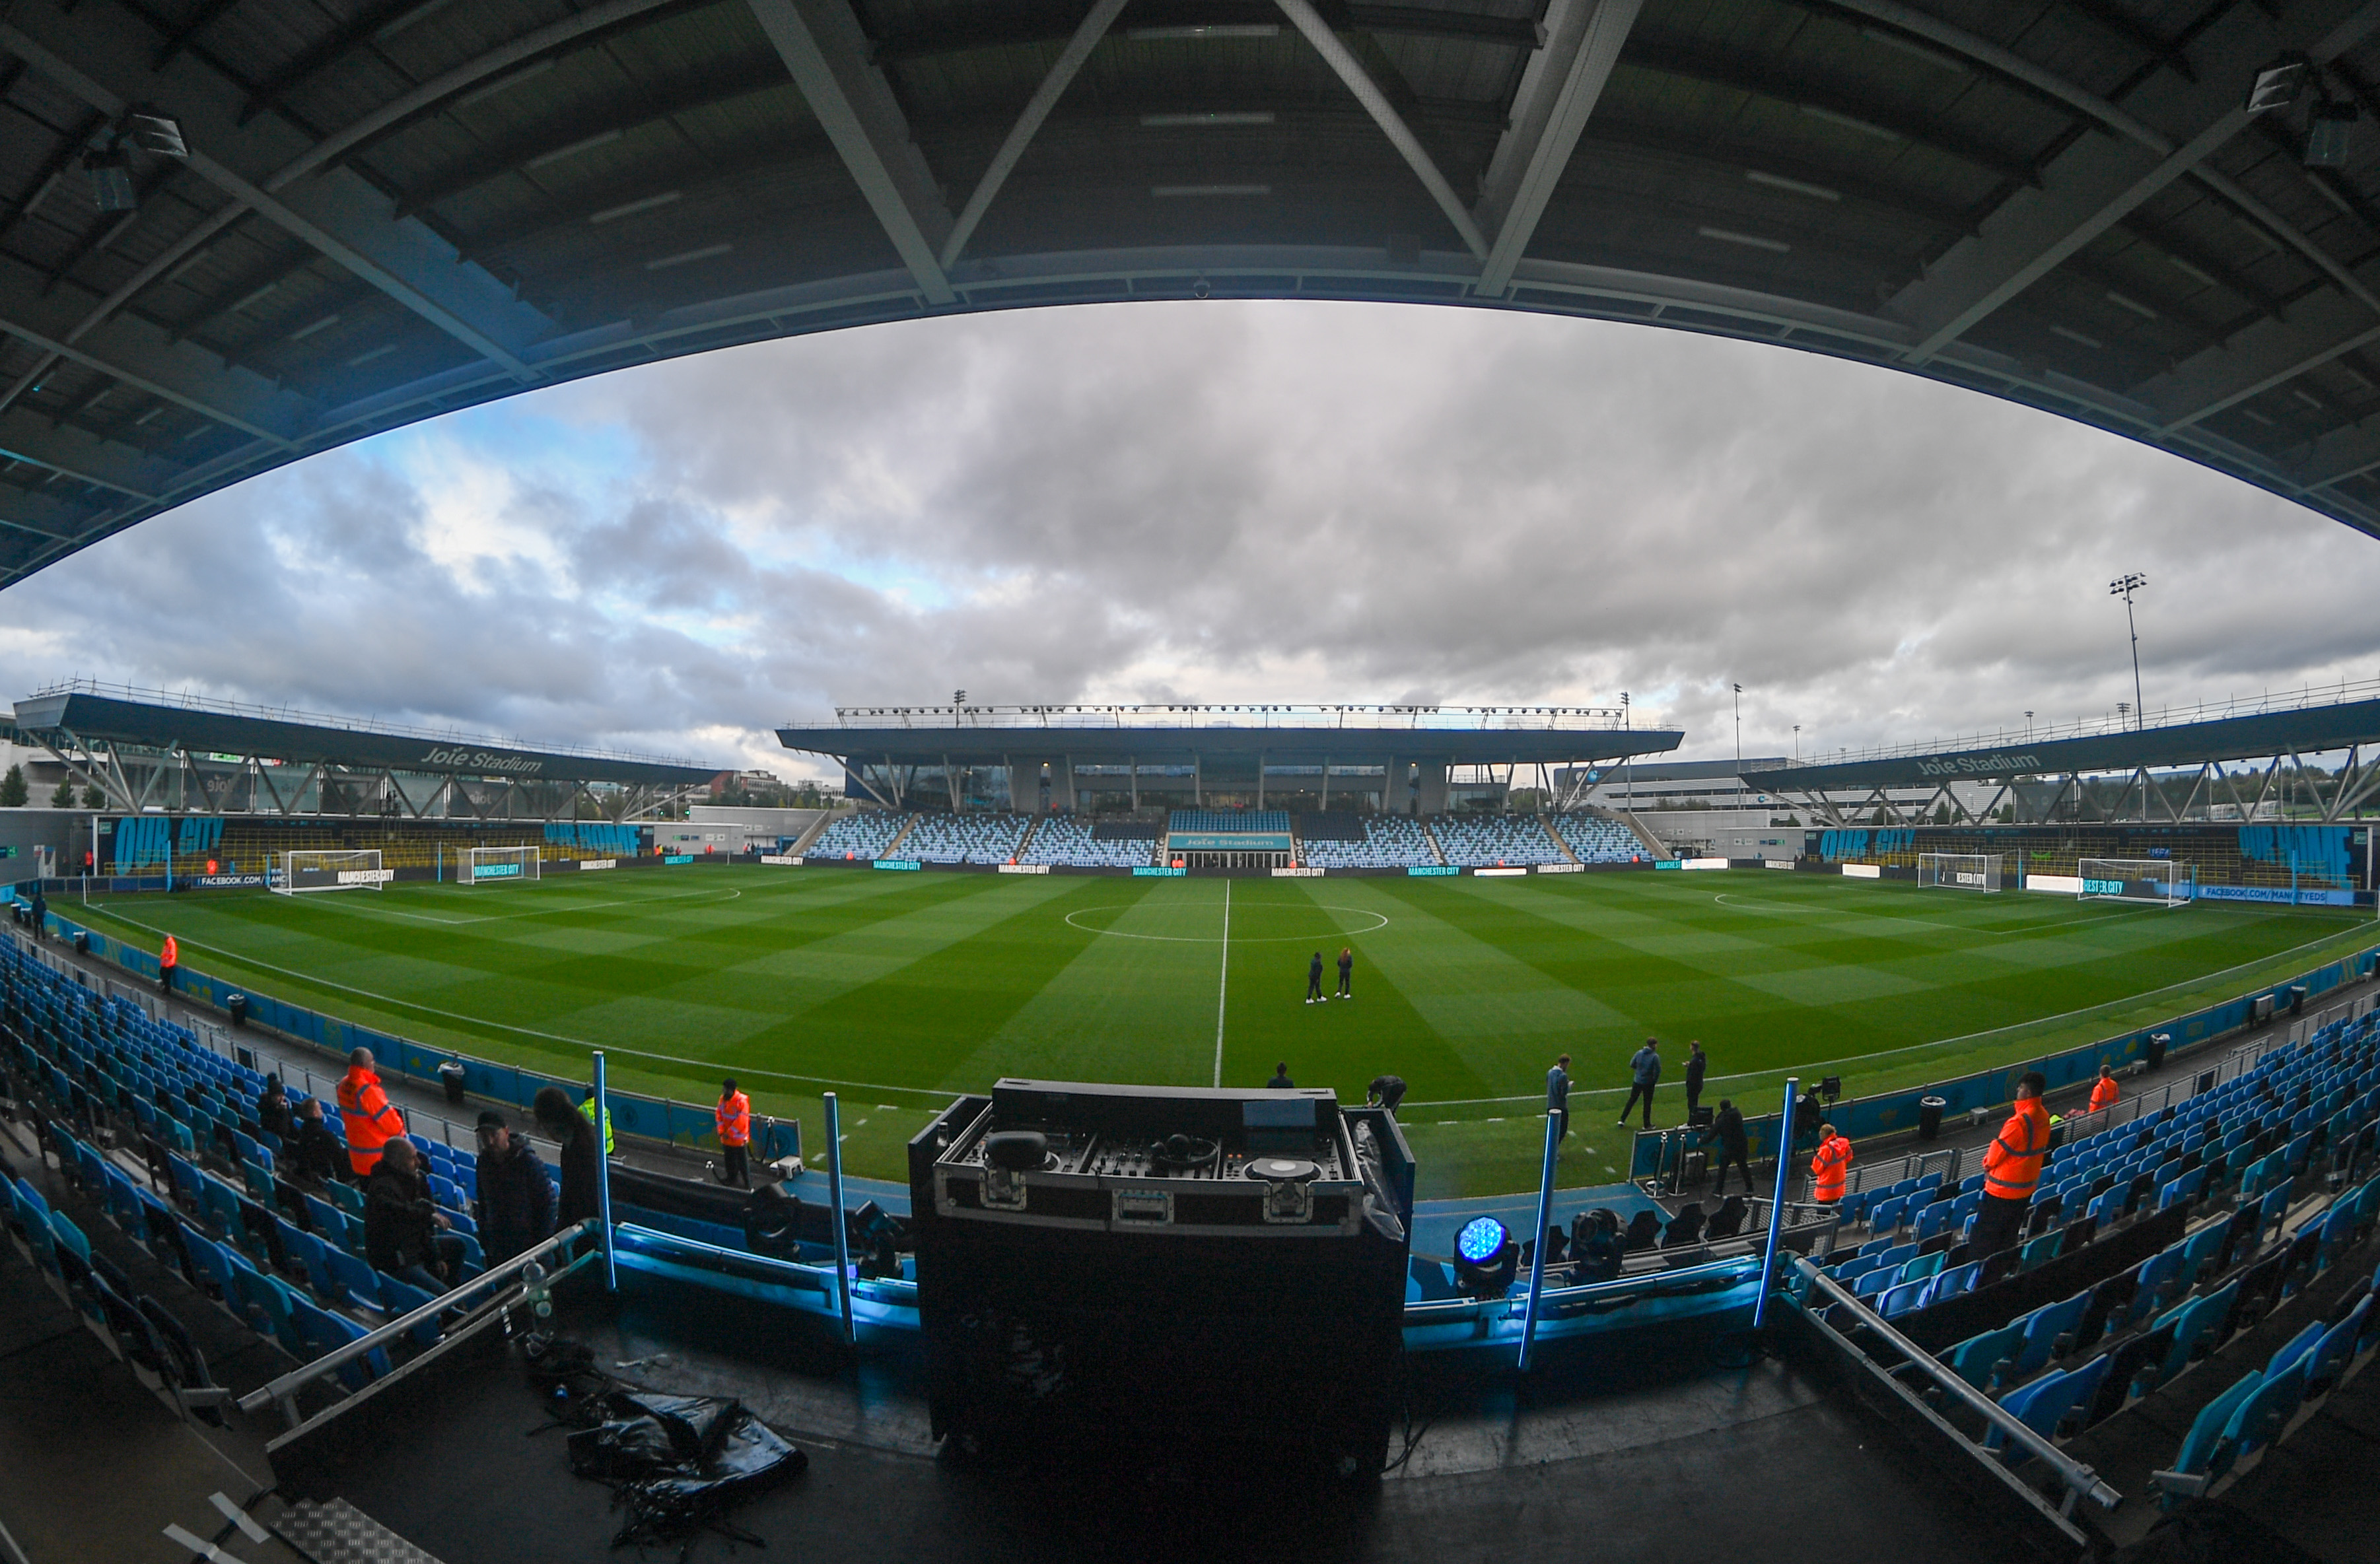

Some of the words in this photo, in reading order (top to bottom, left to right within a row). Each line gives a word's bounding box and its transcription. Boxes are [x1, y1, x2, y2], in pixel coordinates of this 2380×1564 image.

[421, 746, 469, 766] Joie
[469, 753, 542, 772] Stadium
[1917, 757, 1959, 775] Joie
[1956, 755, 2041, 772] Stadium
[115, 817, 171, 876] OUR
[178, 817, 225, 856] CITY
[544, 824, 577, 846] OUR
[577, 824, 641, 857] HOME
[1186, 837, 1216, 847] Joie
[1220, 837, 1274, 846] Stadium
[1819, 830, 1869, 862] OUR
[1874, 829, 1916, 855] CITY
[1296, 838, 1305, 864] Joie
[2239, 826, 2274, 865] OUR
[2276, 826, 2352, 887] HOME
[874, 860, 907, 870] MANCHESTER
[908, 862, 921, 871] CITY
[998, 865, 1036, 874] MANCHESTER
[1037, 865, 1050, 874] CITY
[1133, 867, 1172, 877] MANCHESTER
[1173, 867, 1187, 877] CITY
[1271, 867, 1311, 877] MANCHESTER
[1312, 867, 1325, 877] CITY
[1408, 866, 1446, 875] MANCHESTER
[1447, 866, 1459, 875] CITY
[1537, 864, 1573, 873] MANCHESTER
[1574, 864, 1585, 872] CITY
[2084, 879, 2107, 893] HESTER
[2108, 881, 2123, 893] CITY
